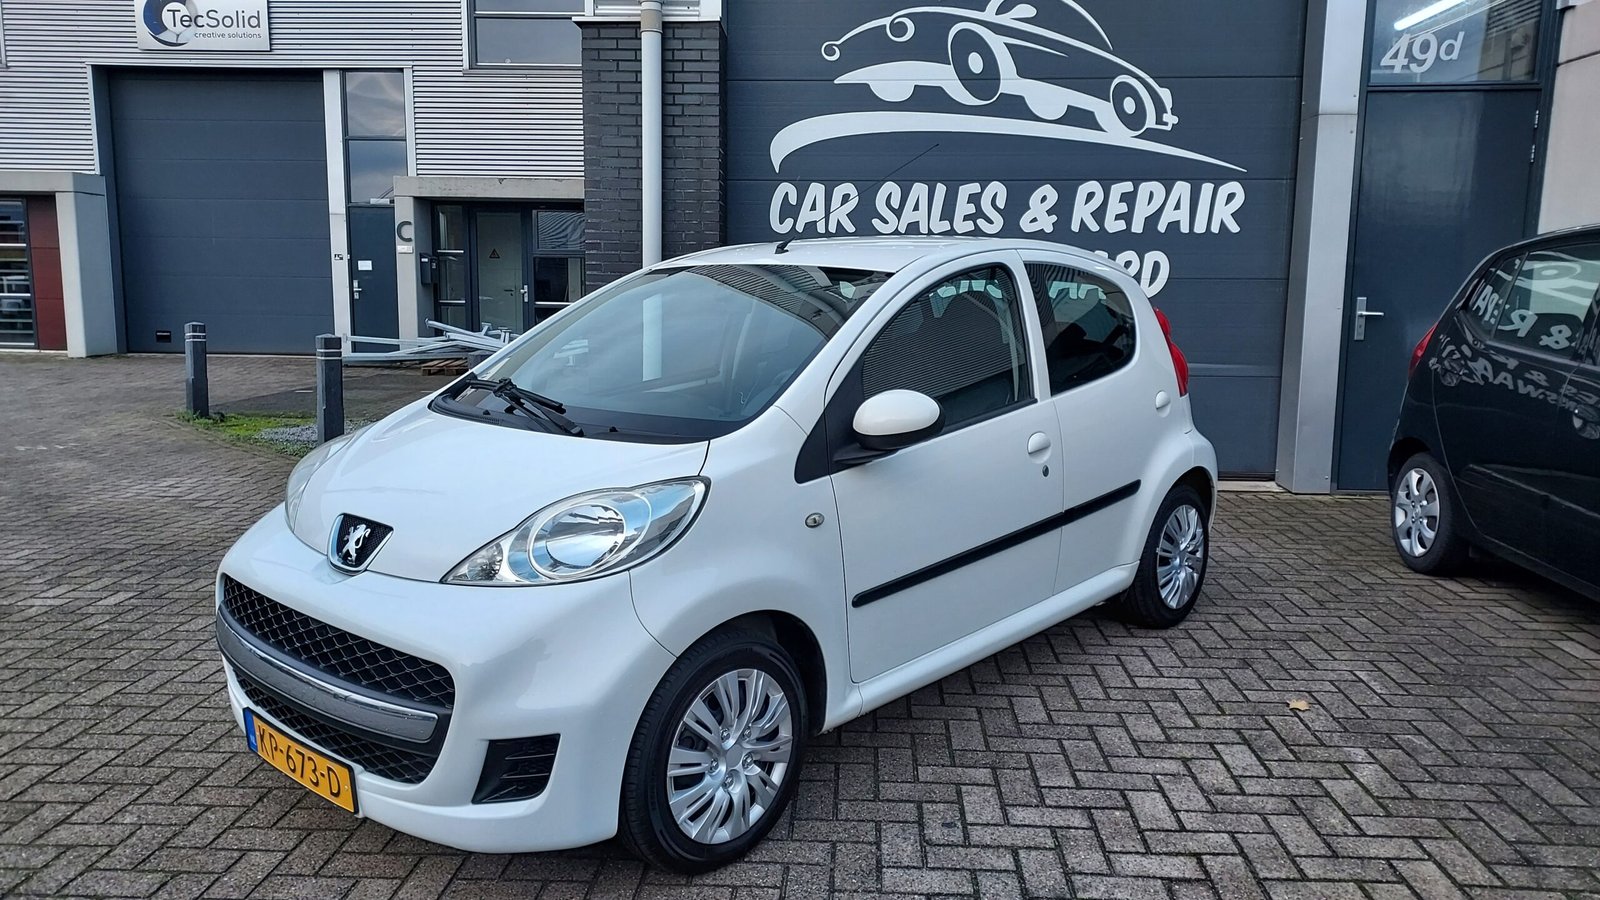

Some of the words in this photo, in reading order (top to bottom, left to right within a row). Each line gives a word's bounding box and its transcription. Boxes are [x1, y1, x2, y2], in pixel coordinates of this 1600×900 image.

[167, 9, 261, 29] TecSolid
[194, 31, 226, 39] creative
[227, 31, 262, 39] solutions
[1380, 31, 1465, 74] 49d
[769, 181, 860, 235] CAR
[871, 180, 1007, 235] SALES
[1019, 183, 1059, 234] &
[1070, 180, 1246, 235] REPAIR
[397, 220, 413, 242] C
[258, 725, 341, 798] KP-673-D
